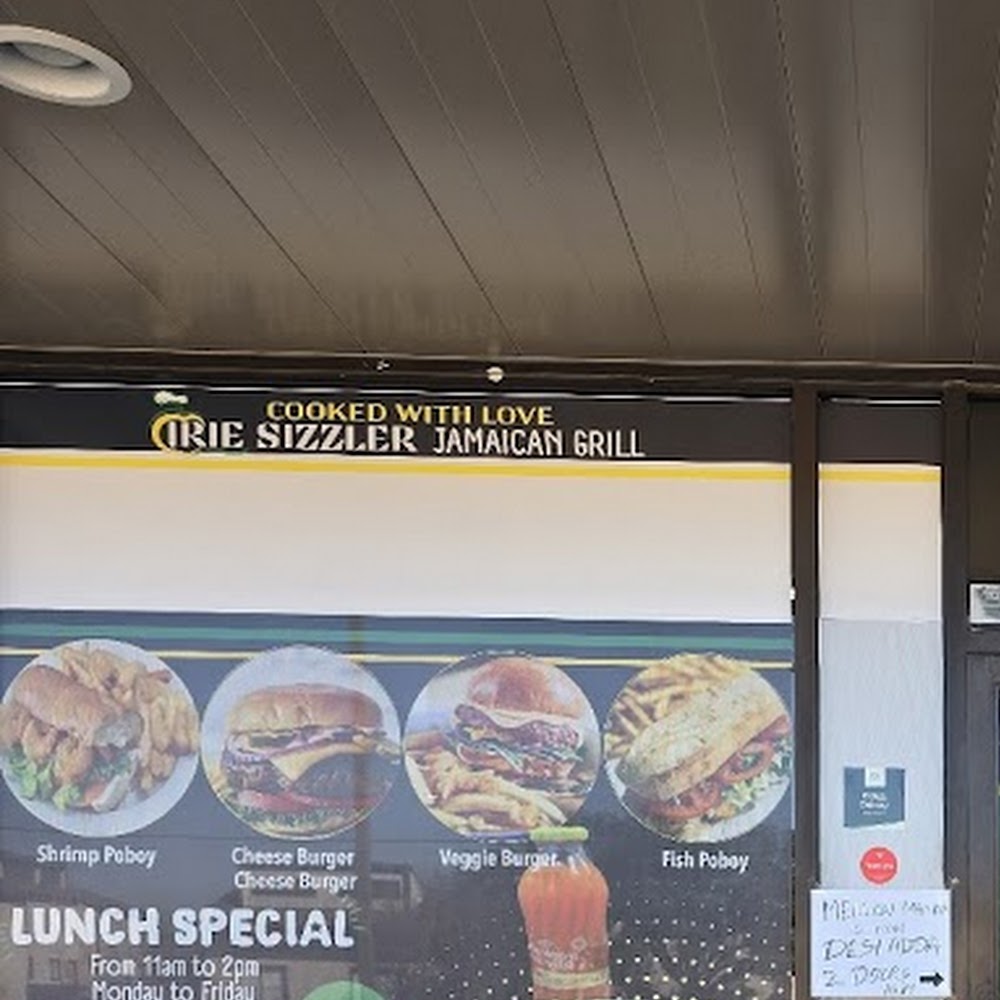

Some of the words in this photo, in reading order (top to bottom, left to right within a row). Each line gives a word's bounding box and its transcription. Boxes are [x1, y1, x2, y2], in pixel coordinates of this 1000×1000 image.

[267, 401, 388, 422] COOKED
[394, 403, 472, 424] WITH
[482, 405, 555, 425] LOVE
[166, 420, 245, 449] IRIE
[257, 422, 418, 453] SIZZLER
[432, 426, 564, 457] JAMAICAN
[573, 428, 646, 458] GRILL
[36, 844, 99, 867] Shrimp
[103, 847, 157, 869] Poboy
[231, 847, 293, 866] Cheese
[297, 847, 355, 870] Burger
[438, 848, 497, 872] Veggie
[661, 850, 697, 870] Fish
[699, 850, 750, 872] Poboy
[233, 871, 295, 890] Cheese
[299, 871, 358, 892] Burger
[10, 906, 161, 947] LUNCH
[172, 906, 355, 948] SPECIAL
[90, 953, 137, 977] From
[143, 955, 190, 977] 11am
[193, 956, 213, 977] to
[221, 955, 260, 984] 2pm
